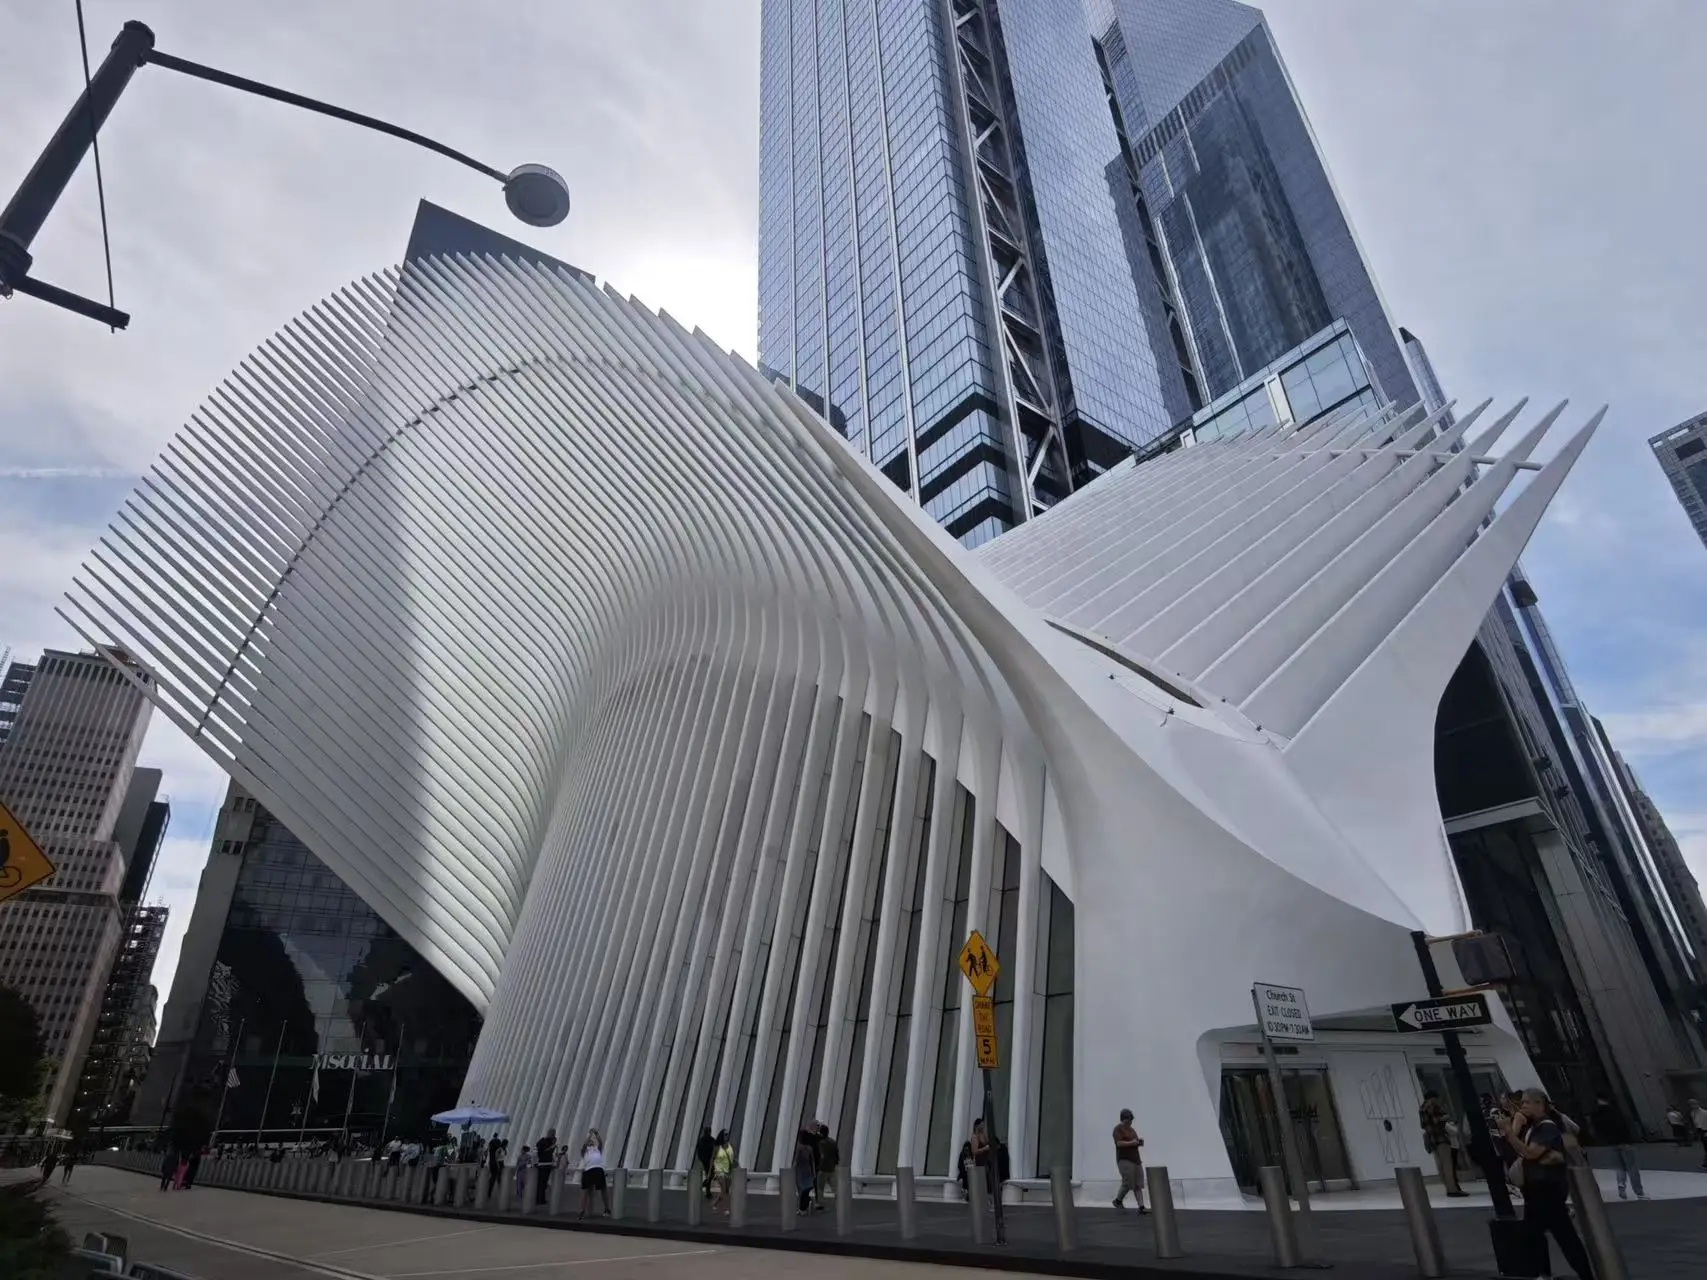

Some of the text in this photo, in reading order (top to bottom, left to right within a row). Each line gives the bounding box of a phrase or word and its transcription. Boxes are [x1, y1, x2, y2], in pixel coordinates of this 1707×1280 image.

[1265, 988, 1297, 1003] Church St
[1267, 1004, 1302, 1019] EXIT CLOSED
[1414, 1004, 1477, 1022] ONE WAY
[982, 1039, 992, 1055] 5
